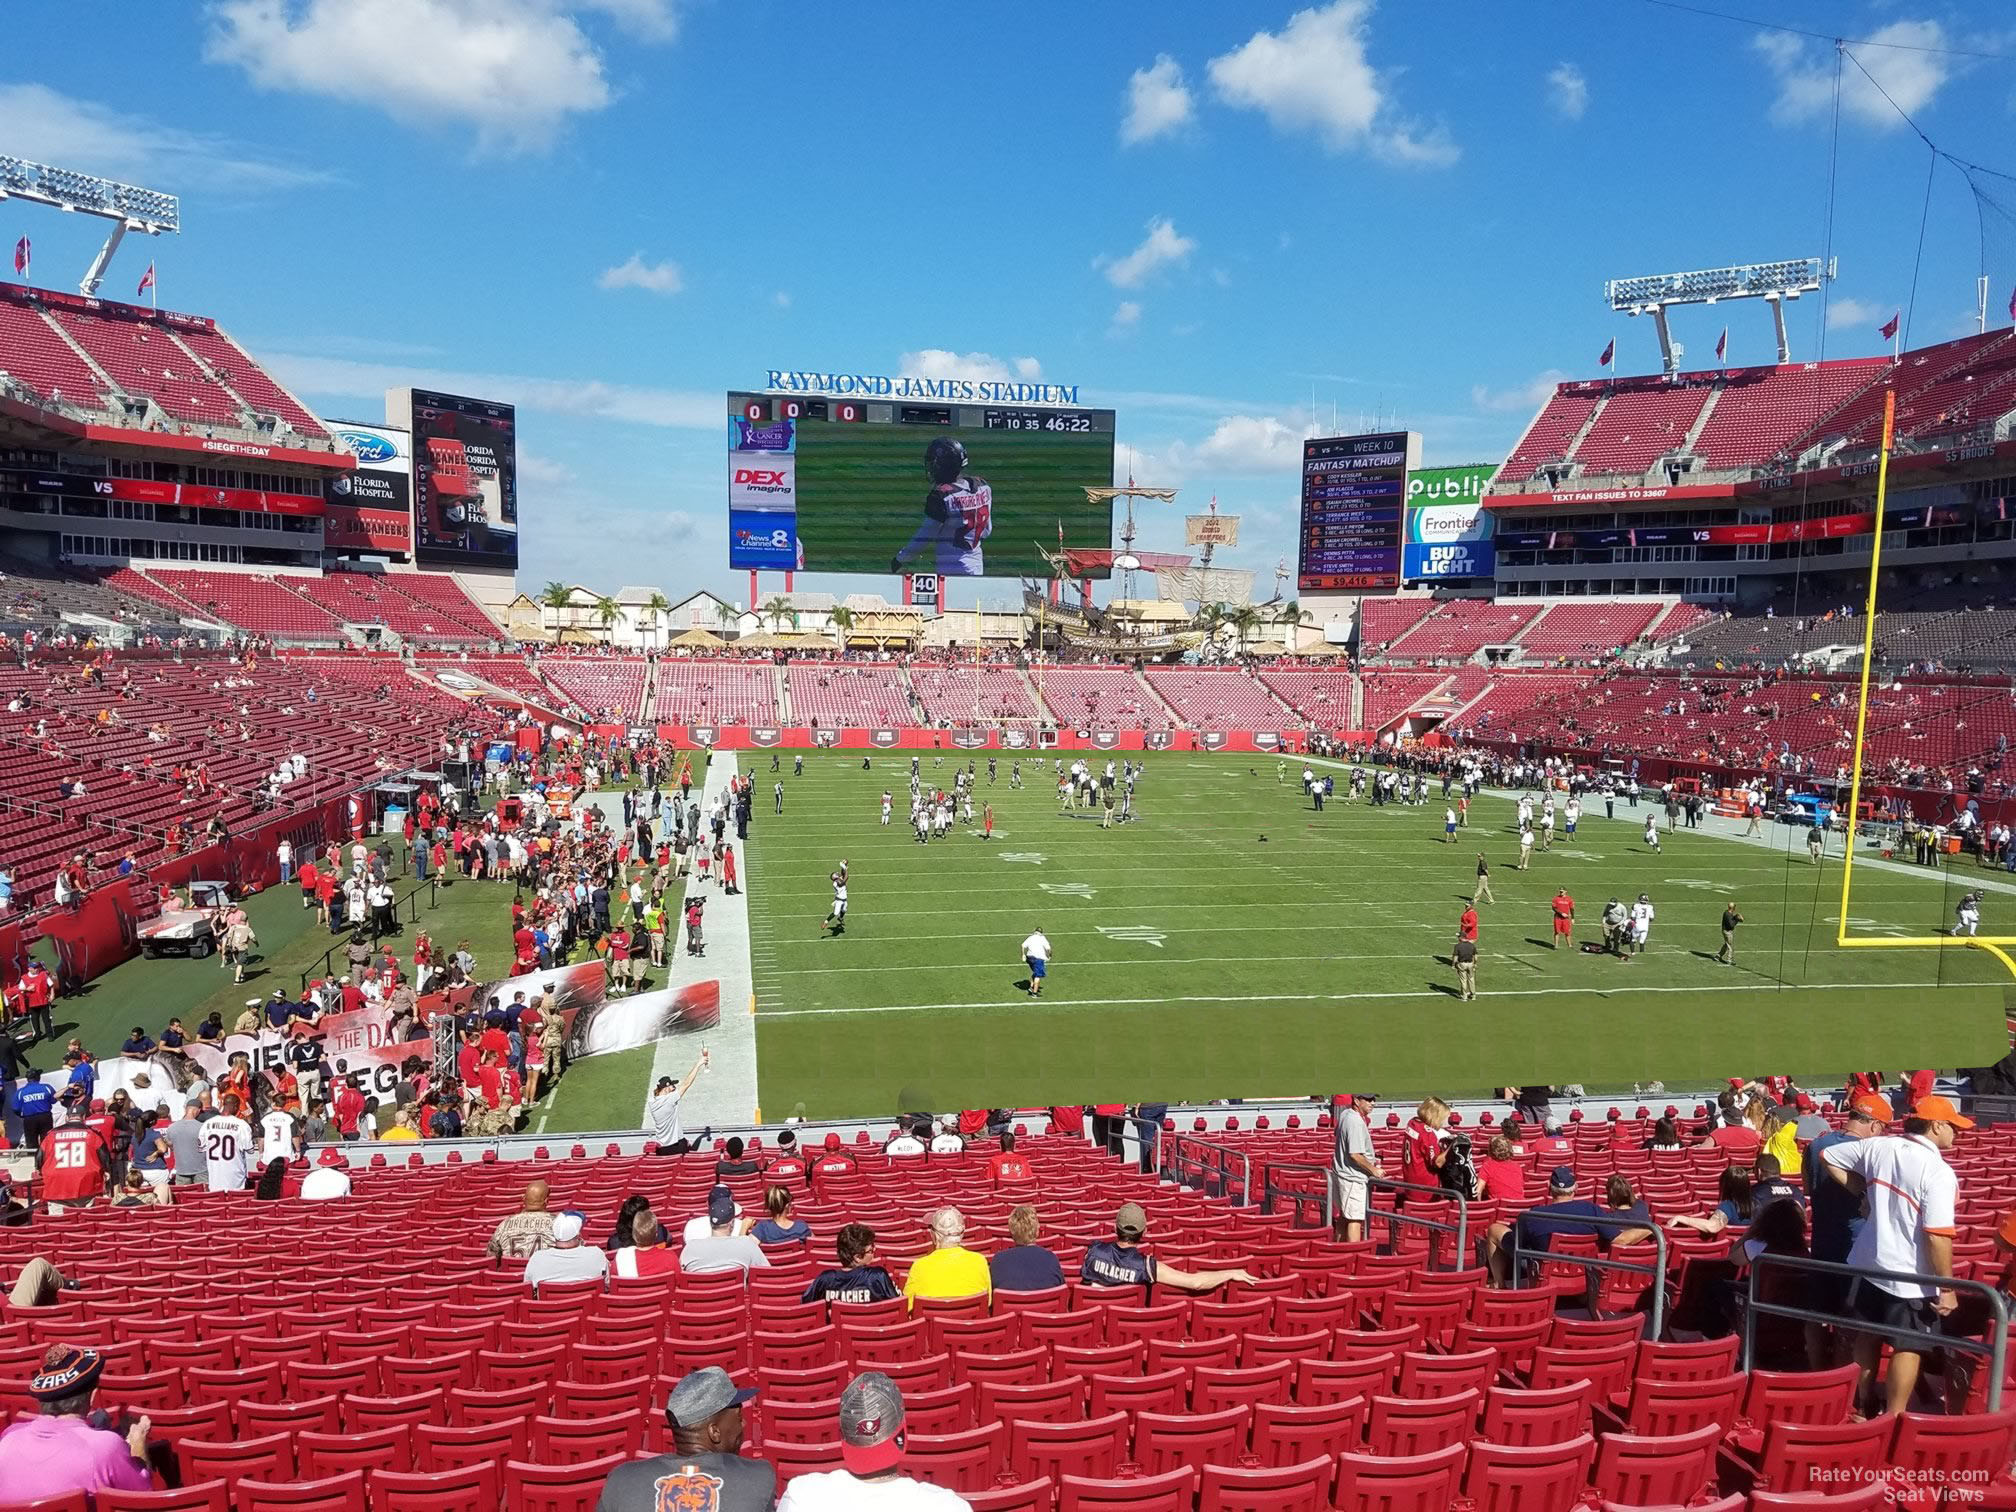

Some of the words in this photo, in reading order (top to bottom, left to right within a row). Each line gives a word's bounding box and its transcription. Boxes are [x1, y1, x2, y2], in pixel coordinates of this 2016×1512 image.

[766, 370, 891, 395] RAYMOND
[895, 377, 973, 400] JAMES
[978, 381, 1079, 404] STADIUM
[749, 405, 760, 419] 0
[787, 403, 799, 417] 0
[843, 406, 854, 420] 0
[987, 418, 1001, 428] 1ST
[1006, 419, 1020, 429] 10
[1025, 419, 1040, 430] 35
[1045, 418, 1090, 432] 46:22
[202, 441, 270, 457] #SIEGETHEDAY
[342, 434, 383, 459] Ford
[1353, 441, 1381, 453] WEEK
[1383, 440, 1394, 450] 10
[1946, 451, 1957, 463] 55
[1958, 446, 1996, 461] BROOKS
[1307, 460, 1352, 472] FANTASY
[1352, 456, 1401, 468] MATCHUP
[1840, 468, 1851, 477] 40
[1853, 463, 1879, 476] ALSTO
[353, 475, 390, 489] FLORIDA
[735, 469, 787, 486] DEX
[1769, 477, 1792, 488] LYNCH
[93, 481, 114, 494] VS
[354, 485, 395, 499] HOSPITAL
[746, 484, 792, 494] imaging
[1552, 493, 1574, 502] TEXT
[1575, 492, 1593, 501] FAN
[1594, 491, 1627, 500] ISSUES
[1628, 490, 1641, 499] TO
[1642, 489, 1667, 498] 33607
[1425, 516, 1481, 530] Frontier
[748, 534, 770, 542] News
[771, 529, 788, 548] 8
[1692, 531, 1711, 541] VS
[740, 539, 772, 548] Channel
[1429, 546, 1469, 561] BUD
[1421, 559, 1475, 575] LIGHT
[916, 578, 935, 590] 40
[335, 1030, 362, 1050] THE
[367, 1022, 396, 1050] DA
[22, 1092, 46, 1103] SENTRY
[211, 1121, 240, 1131] WILLIAMS
[273, 1125, 282, 1142] 3
[207, 1133, 236, 1161] 20
[54, 1140, 87, 1169] 58
[1093, 1259, 1136, 1283] URLACHER
[825, 1288, 871, 1302] URLACHER
